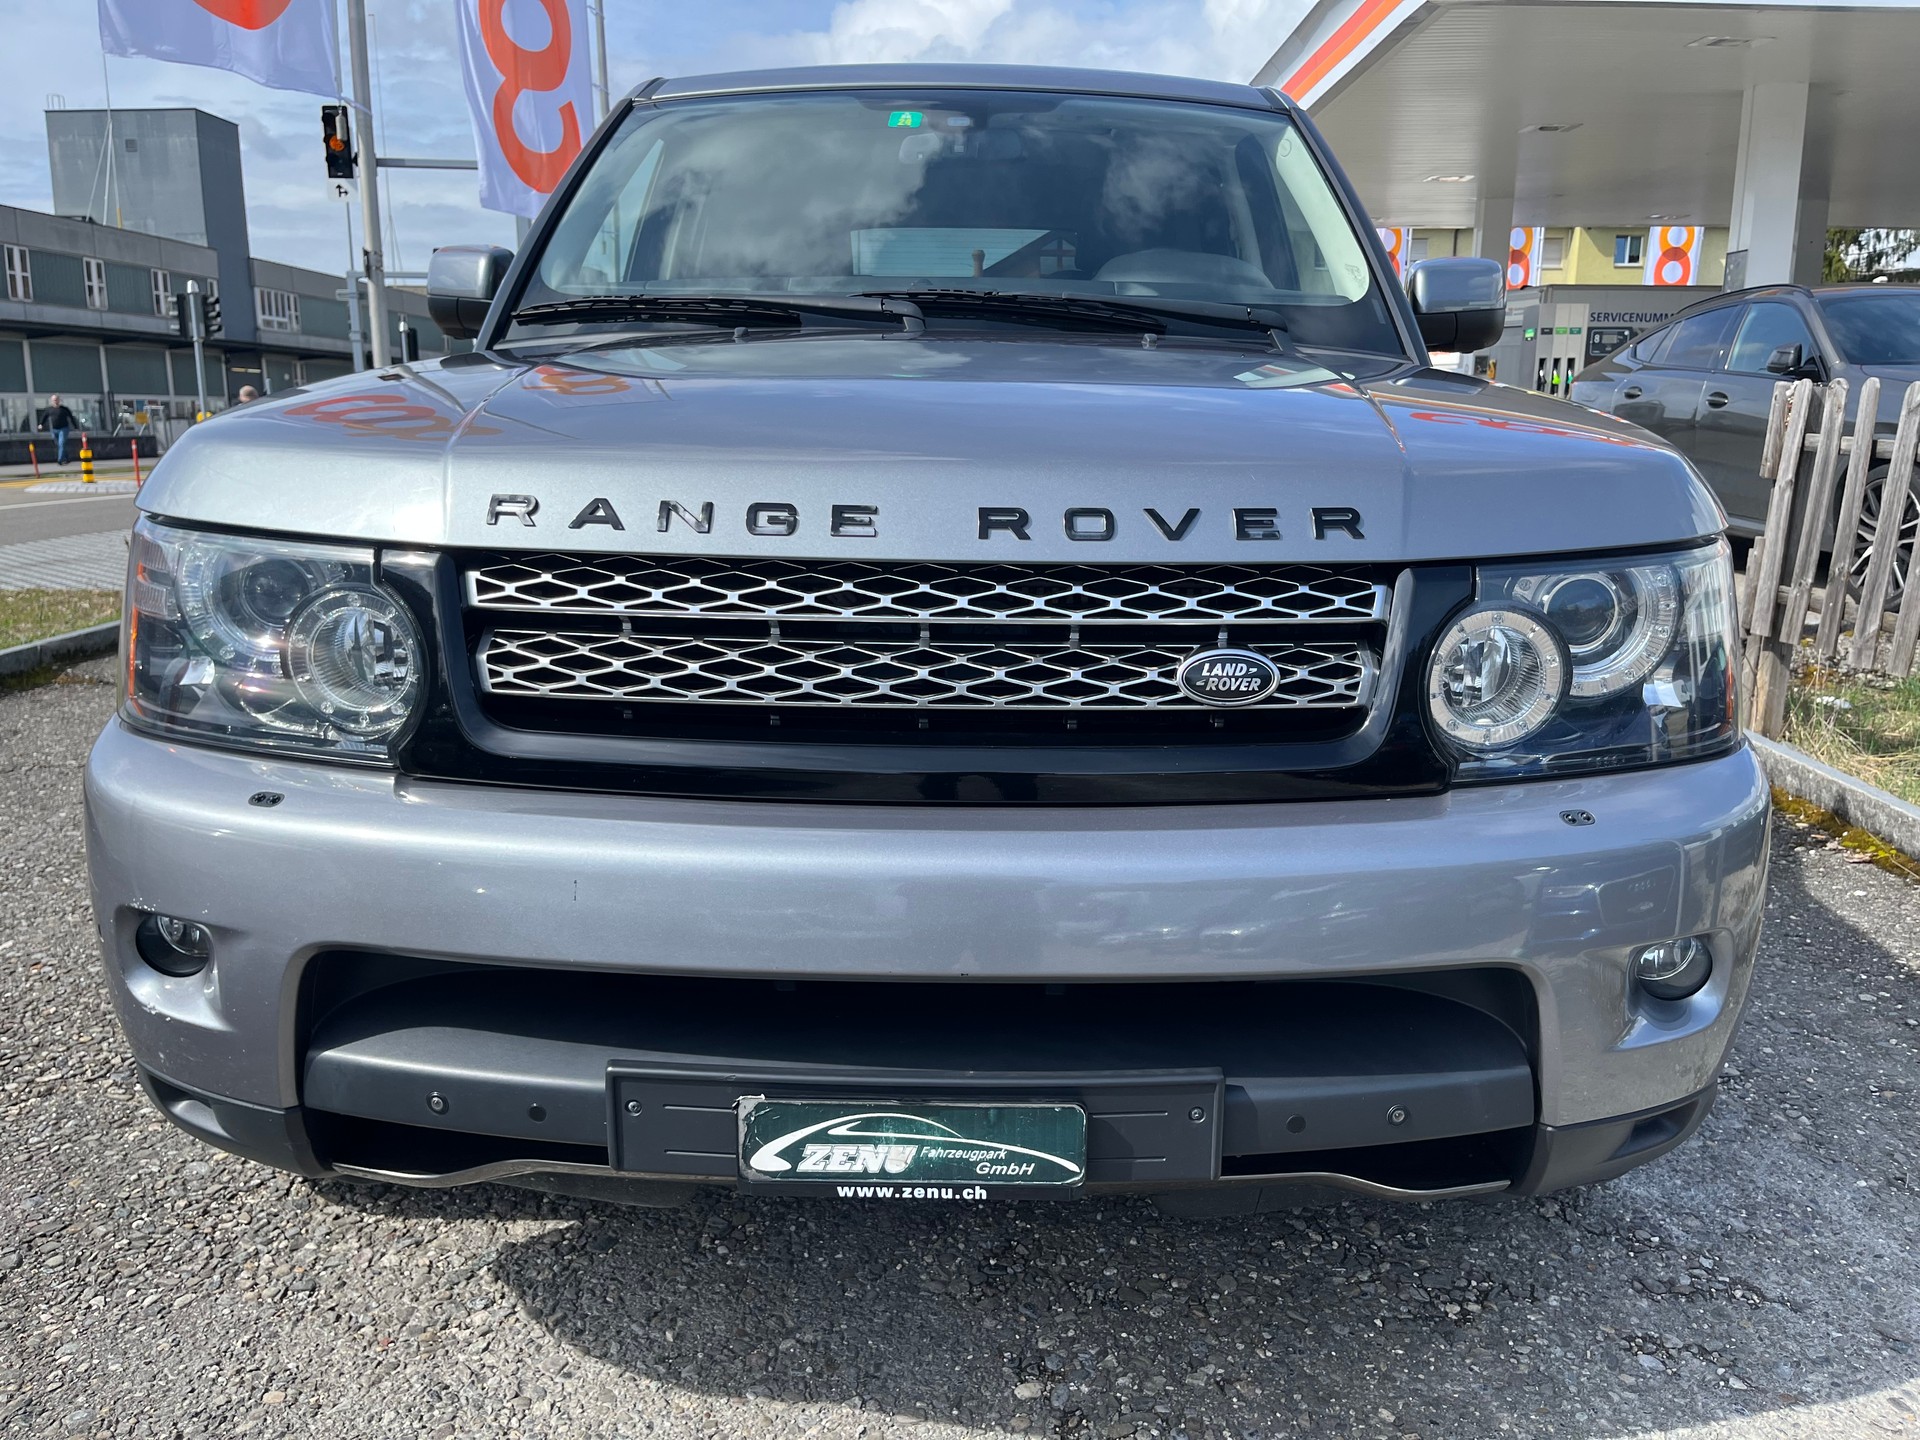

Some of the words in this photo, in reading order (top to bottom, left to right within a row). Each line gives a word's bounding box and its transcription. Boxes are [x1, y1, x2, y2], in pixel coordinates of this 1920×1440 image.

[486, 493, 879, 537] RANGE
[976, 506, 1366, 542] ROVER
[796, 1144, 918, 1173] ZENU
[920, 1146, 1008, 1162] Fahrzeugpark
[976, 1162, 1035, 1176] GmbH
[837, 1185, 988, 1201] www.zenu.ch
